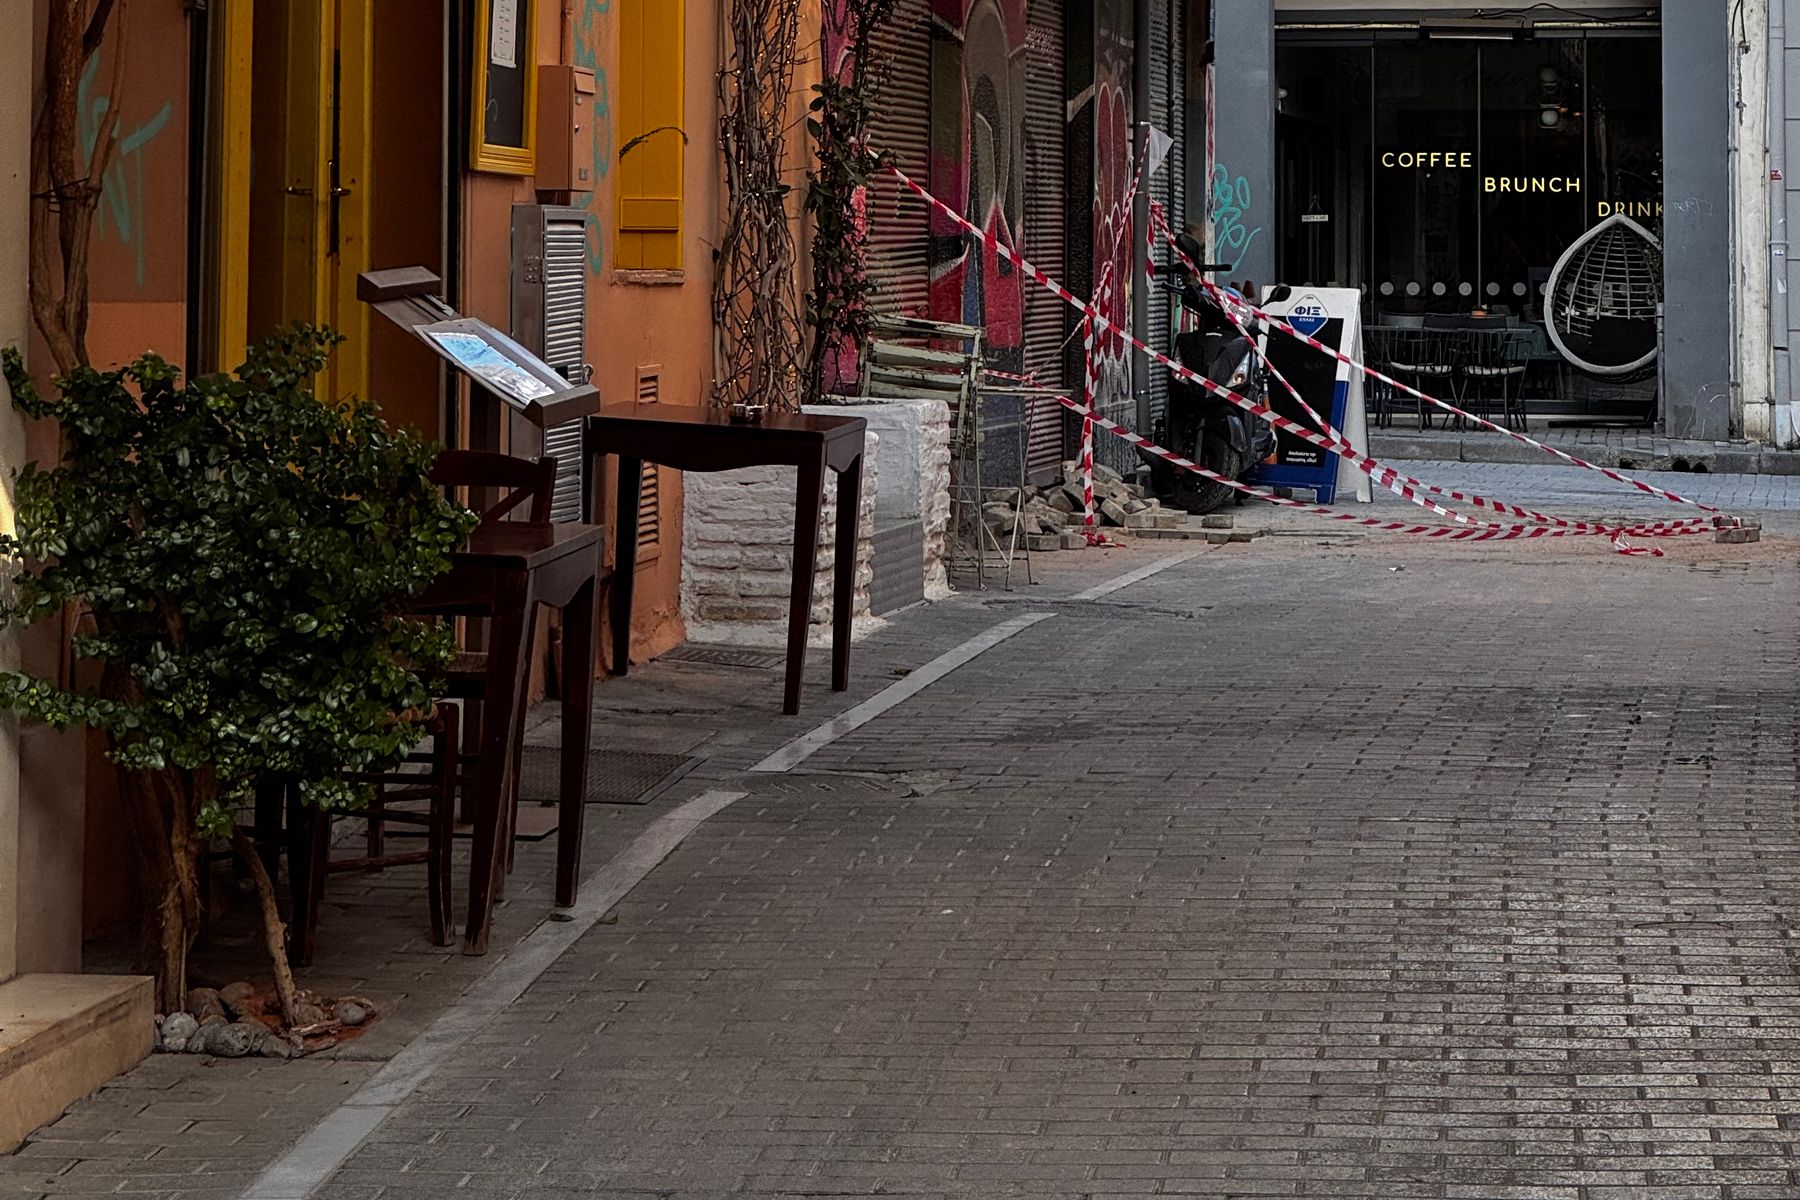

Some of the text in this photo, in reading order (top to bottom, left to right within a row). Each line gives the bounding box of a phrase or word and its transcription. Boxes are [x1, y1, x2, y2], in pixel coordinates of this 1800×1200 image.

[1381, 152, 1472, 169] COFFEE
[1484, 176, 1580, 193] BRUNCH
[1294, 305, 1322, 316] ΦΙΞ
